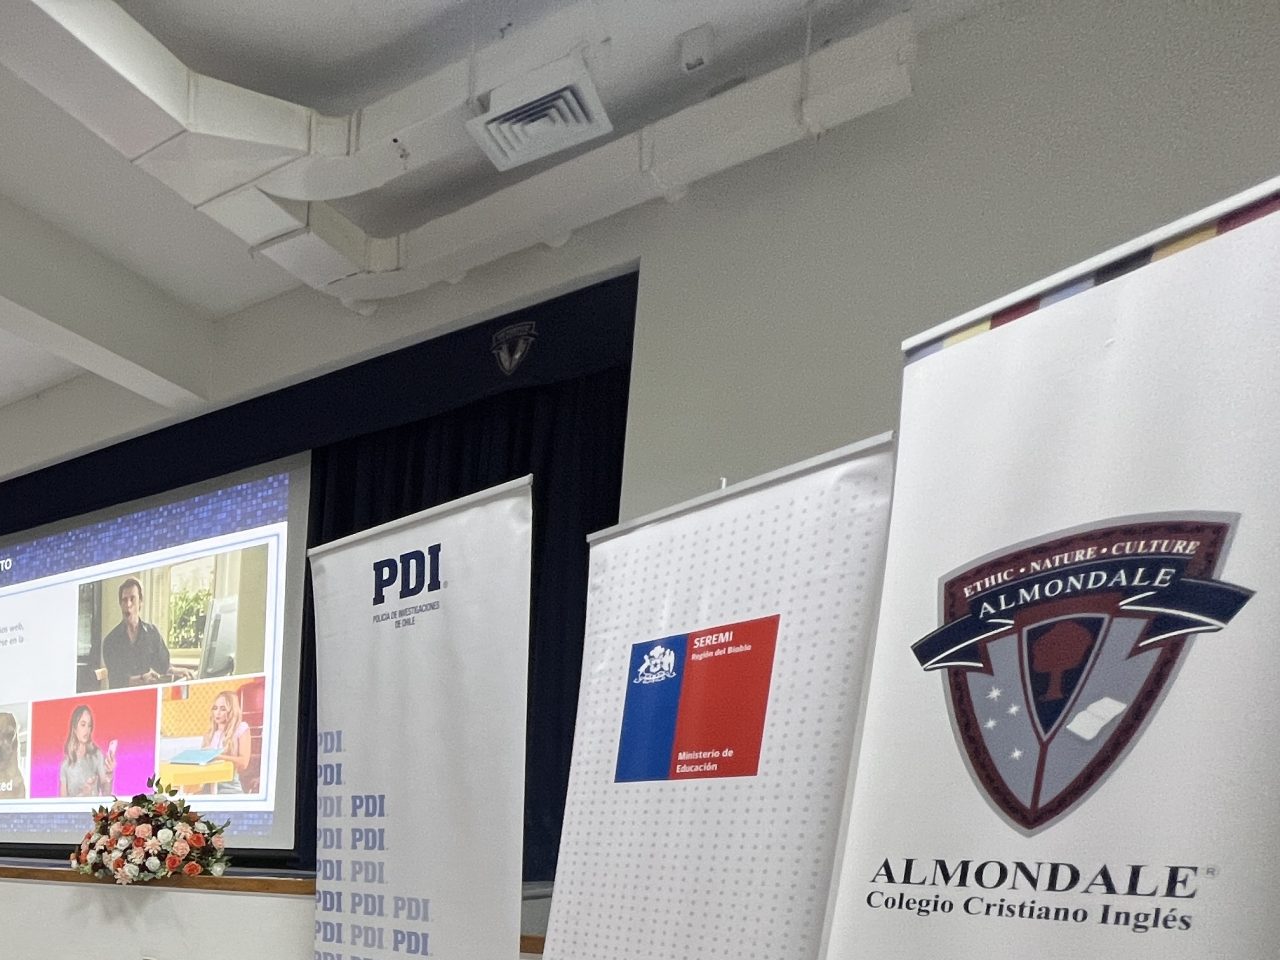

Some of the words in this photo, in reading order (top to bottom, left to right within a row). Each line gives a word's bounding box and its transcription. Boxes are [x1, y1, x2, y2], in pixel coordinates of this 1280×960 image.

[372, 543, 441, 606] PDI
[963, 568, 1014, 598] ETHIC
[1030, 546, 1098, 574] NATURE
[1111, 540, 1200, 556] CULTURE
[978, 567, 1177, 619] ALMONDALE
[693, 631, 734, 649] SEREMI
[675, 762, 718, 773] Educación
[677, 749, 720, 761] Ministerio
[721, 748, 734, 758] de
[350, 794, 386, 818] PDI
[350, 827, 386, 851] PDI
[350, 860, 386, 884] PDI
[870, 857, 1199, 899] ALMONDALE
[350, 892, 385, 917] PDI
[393, 896, 431, 922] PDI
[865, 890, 954, 917] Colegio
[963, 896, 1088, 924] Cristiano
[1098, 904, 1194, 934] Inglés
[350, 924, 385, 950] PDI
[392, 929, 430, 957] PDI
